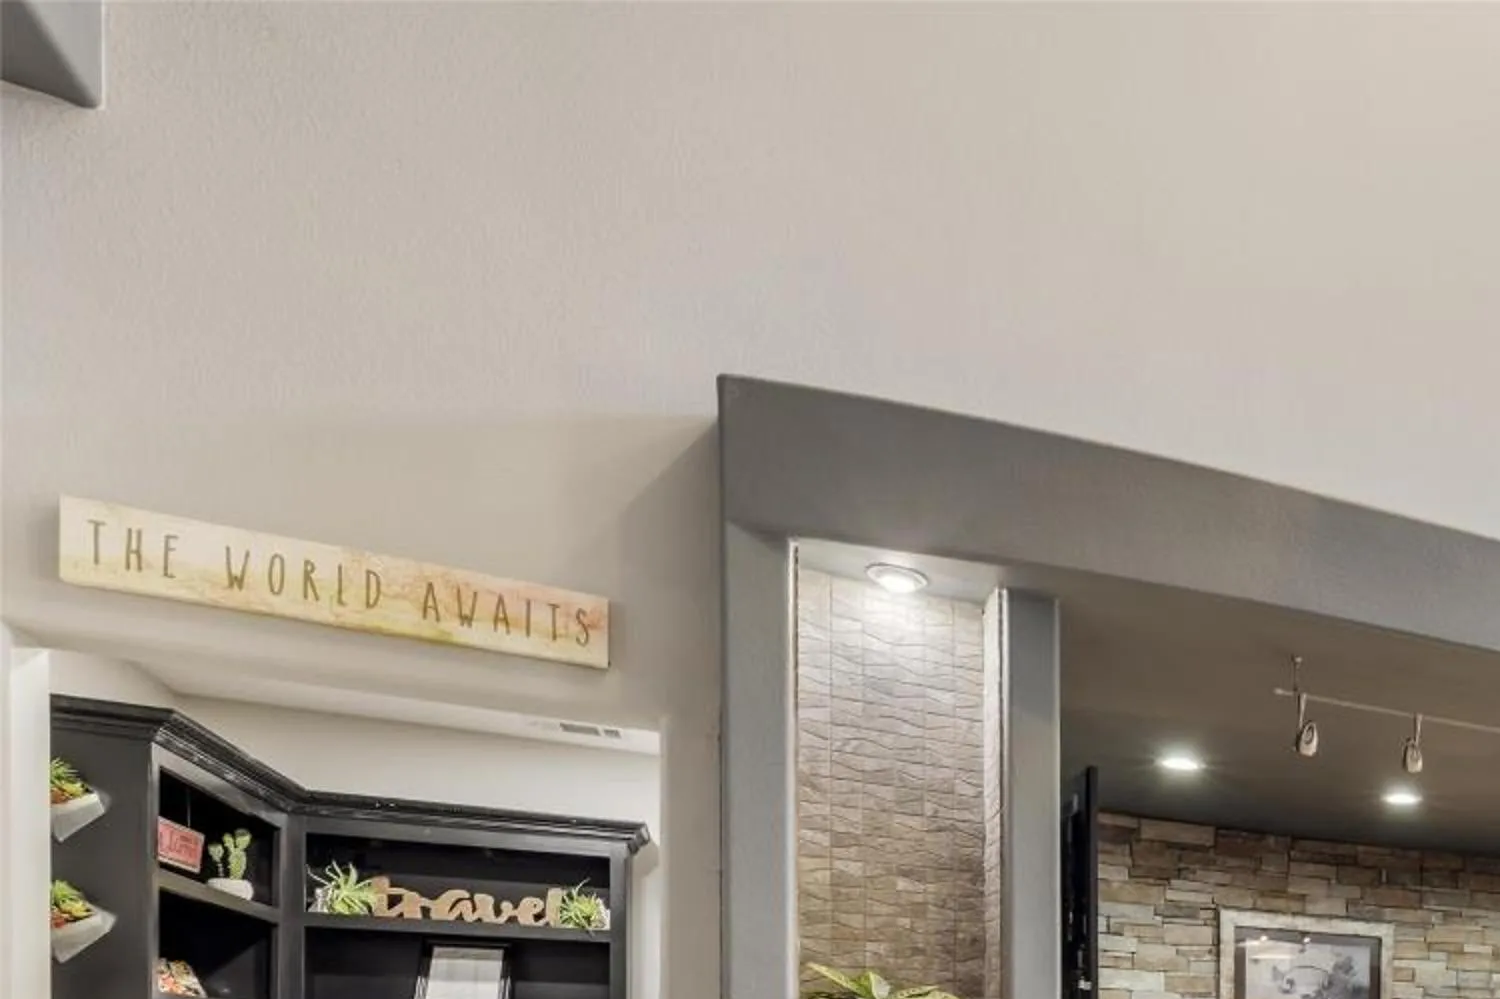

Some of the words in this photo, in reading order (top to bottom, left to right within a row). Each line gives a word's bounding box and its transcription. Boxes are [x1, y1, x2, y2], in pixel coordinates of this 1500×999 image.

[87, 519, 180, 579] THE
[225, 545, 382, 610] WORLD
[421, 581, 591, 648] AWAITS
[370, 875, 566, 929] travel
